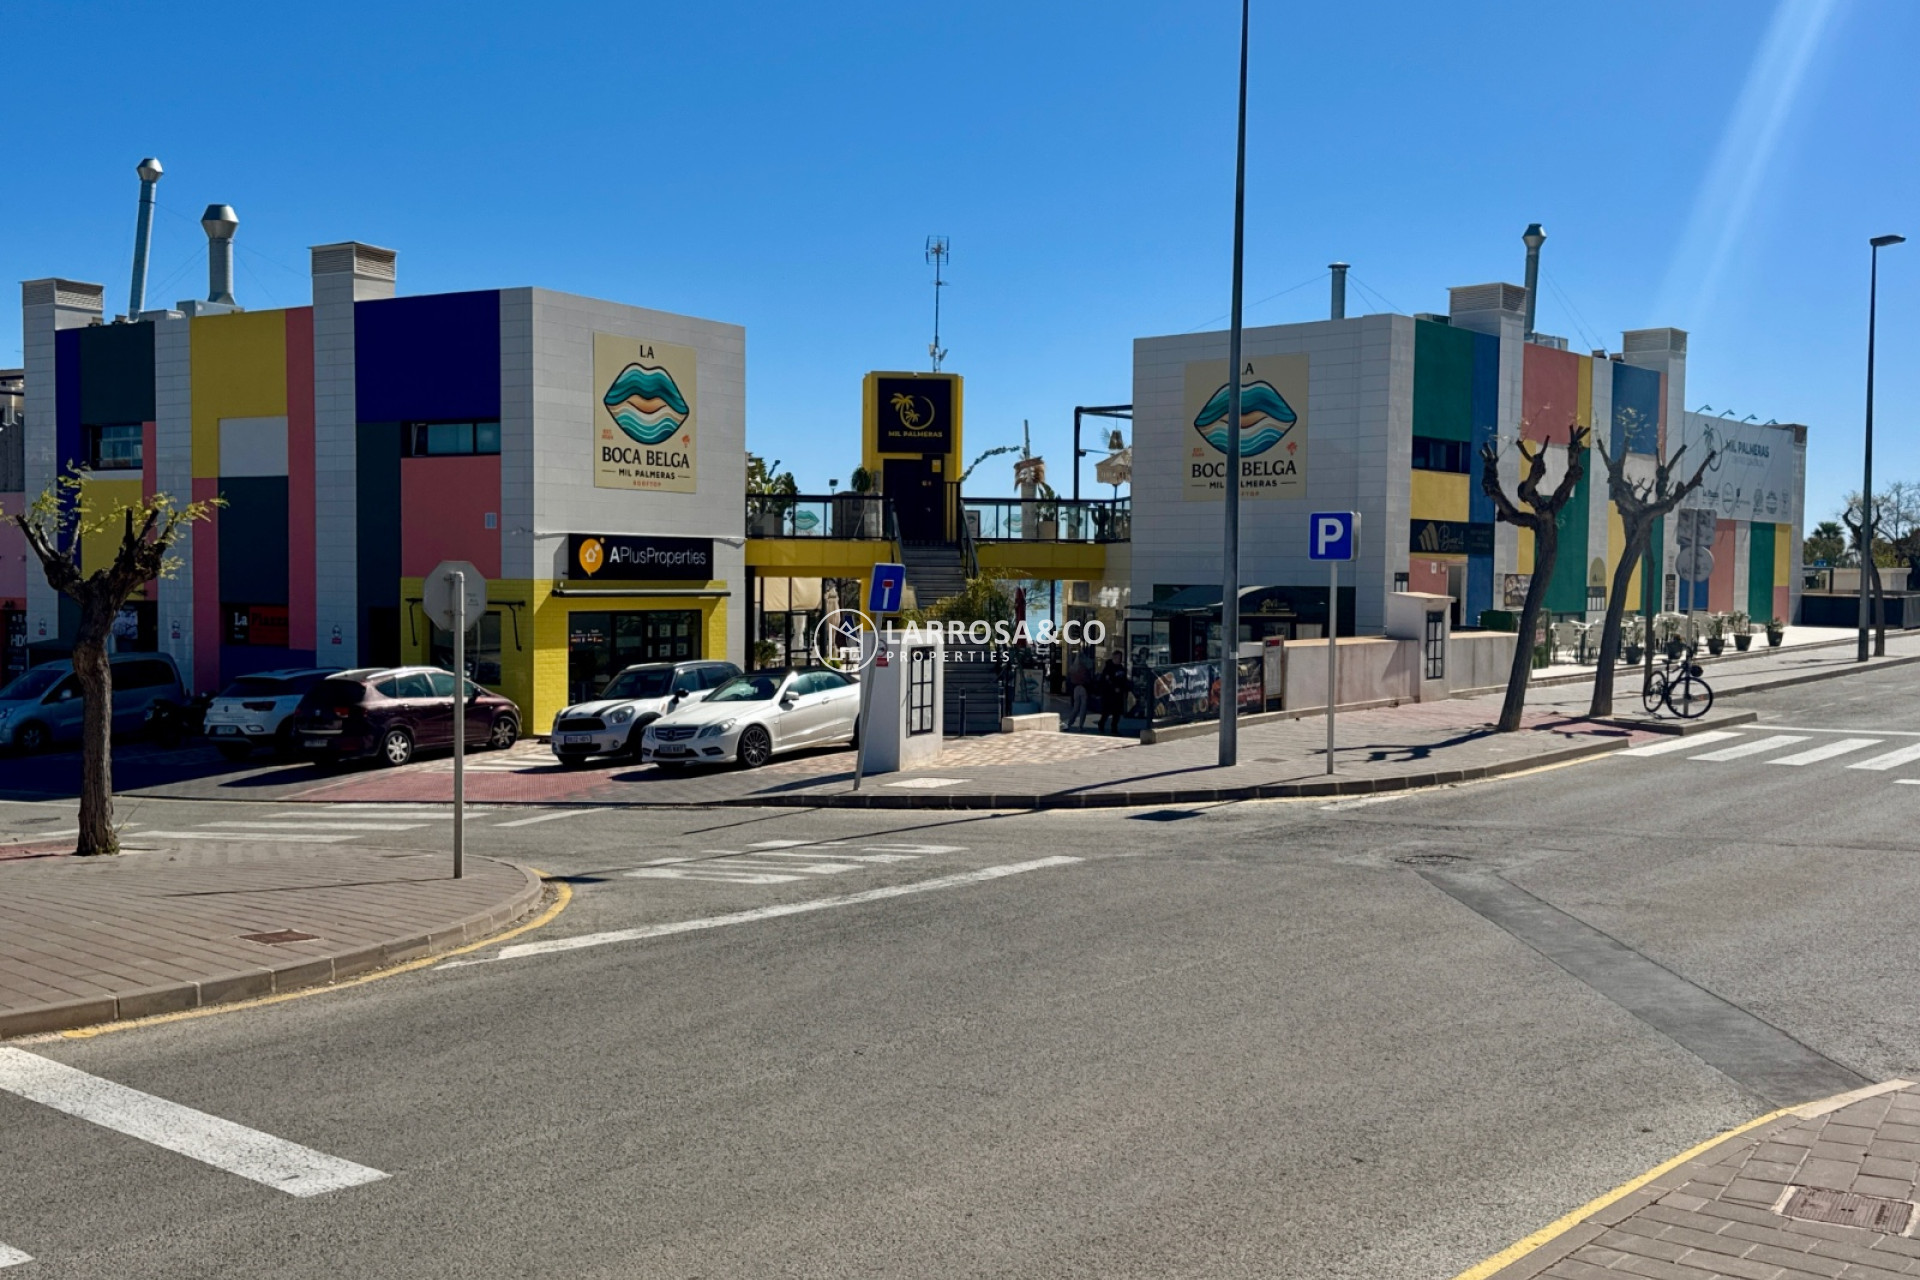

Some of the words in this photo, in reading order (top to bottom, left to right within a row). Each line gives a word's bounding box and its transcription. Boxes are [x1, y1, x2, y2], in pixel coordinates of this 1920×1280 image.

[640, 344, 654, 359] LA
[903, 430, 943, 438] PALMERAS
[602, 446, 642, 465] BOCA
[646, 449, 690, 469] BELGA
[1738, 441, 1770, 458] PALMERAS
[618, 468, 632, 477] MIL
[635, 470, 675, 480] PALMERAS
[1192, 462, 1227, 478] BOC
[1242, 460, 1296, 477] BELGA
[1209, 481, 1224, 489] MIL
[1240, 480, 1277, 488] LMERAS
[1318, 518, 1344, 555] P
[609, 546, 706, 567] APlusProperties
[234, 612, 248, 626] La
